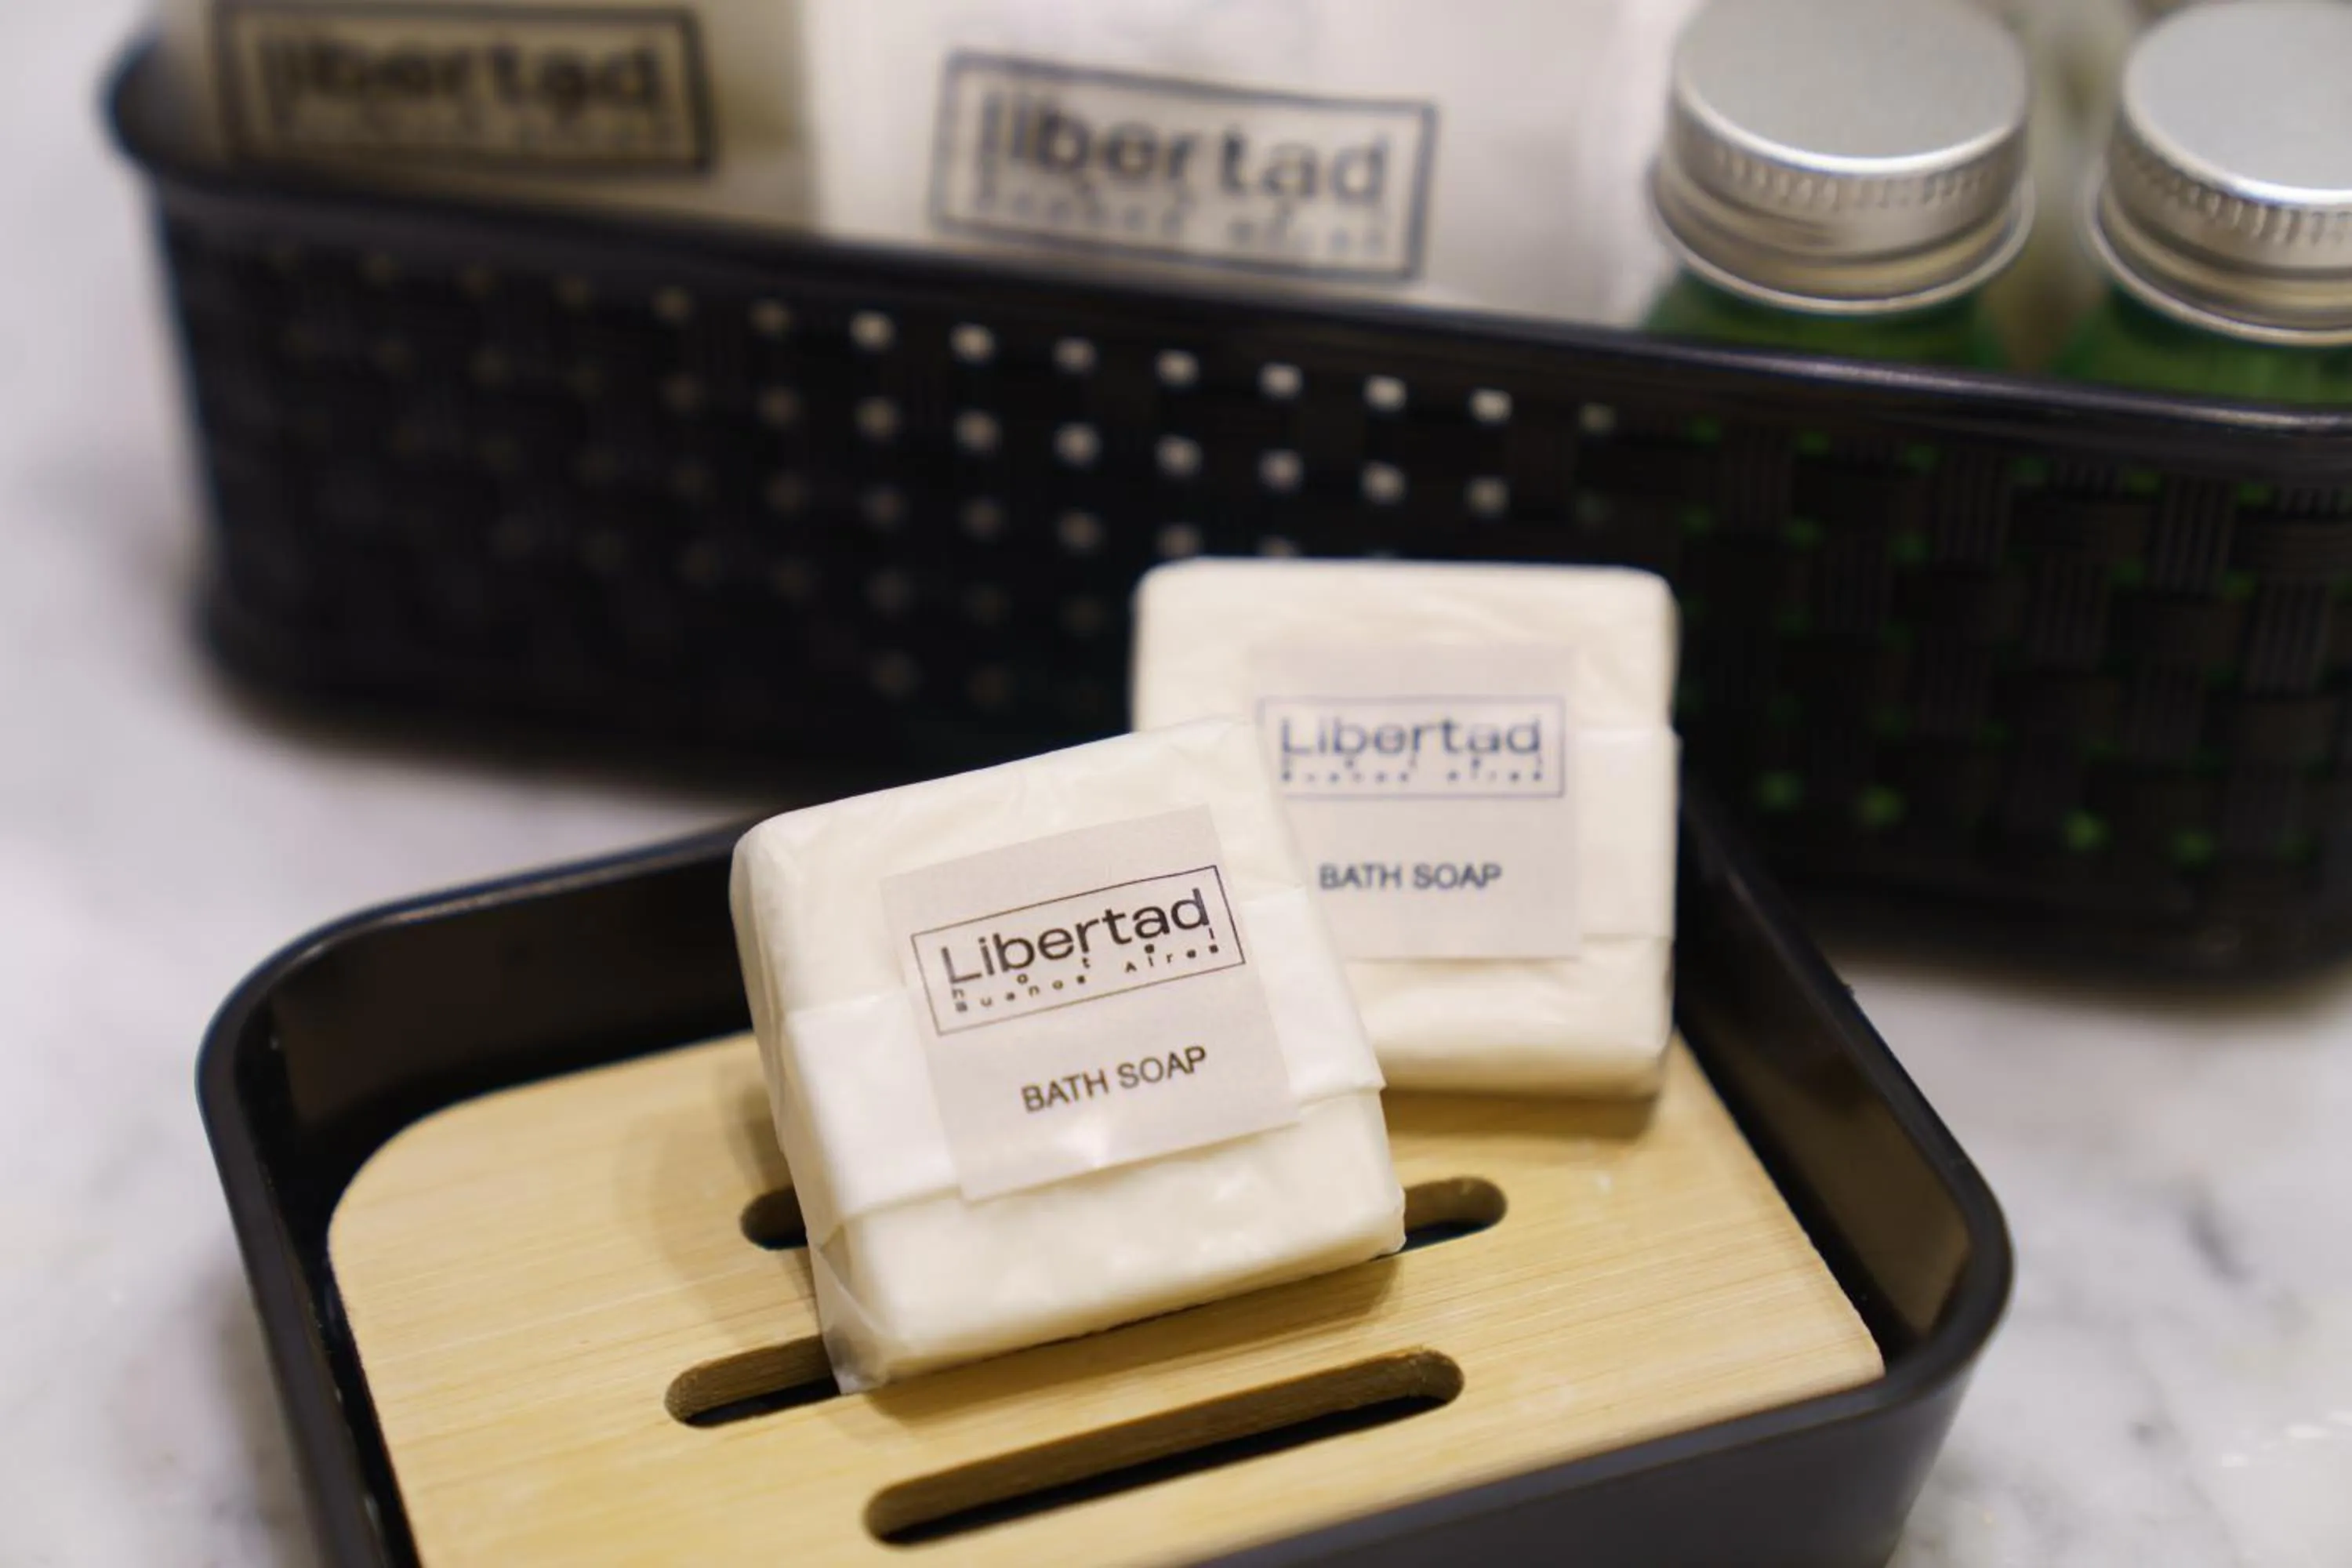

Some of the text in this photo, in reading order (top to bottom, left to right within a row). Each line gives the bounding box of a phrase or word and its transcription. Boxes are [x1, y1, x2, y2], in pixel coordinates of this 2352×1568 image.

[1280, 717, 1542, 756] Libertad
[1319, 863, 1502, 889] BATH SOAP
[941, 887, 1210, 984] Libertad
[955, 944, 1219, 1013] Buenos Aires
[1021, 1045, 1207, 1113] BATH SOAP
